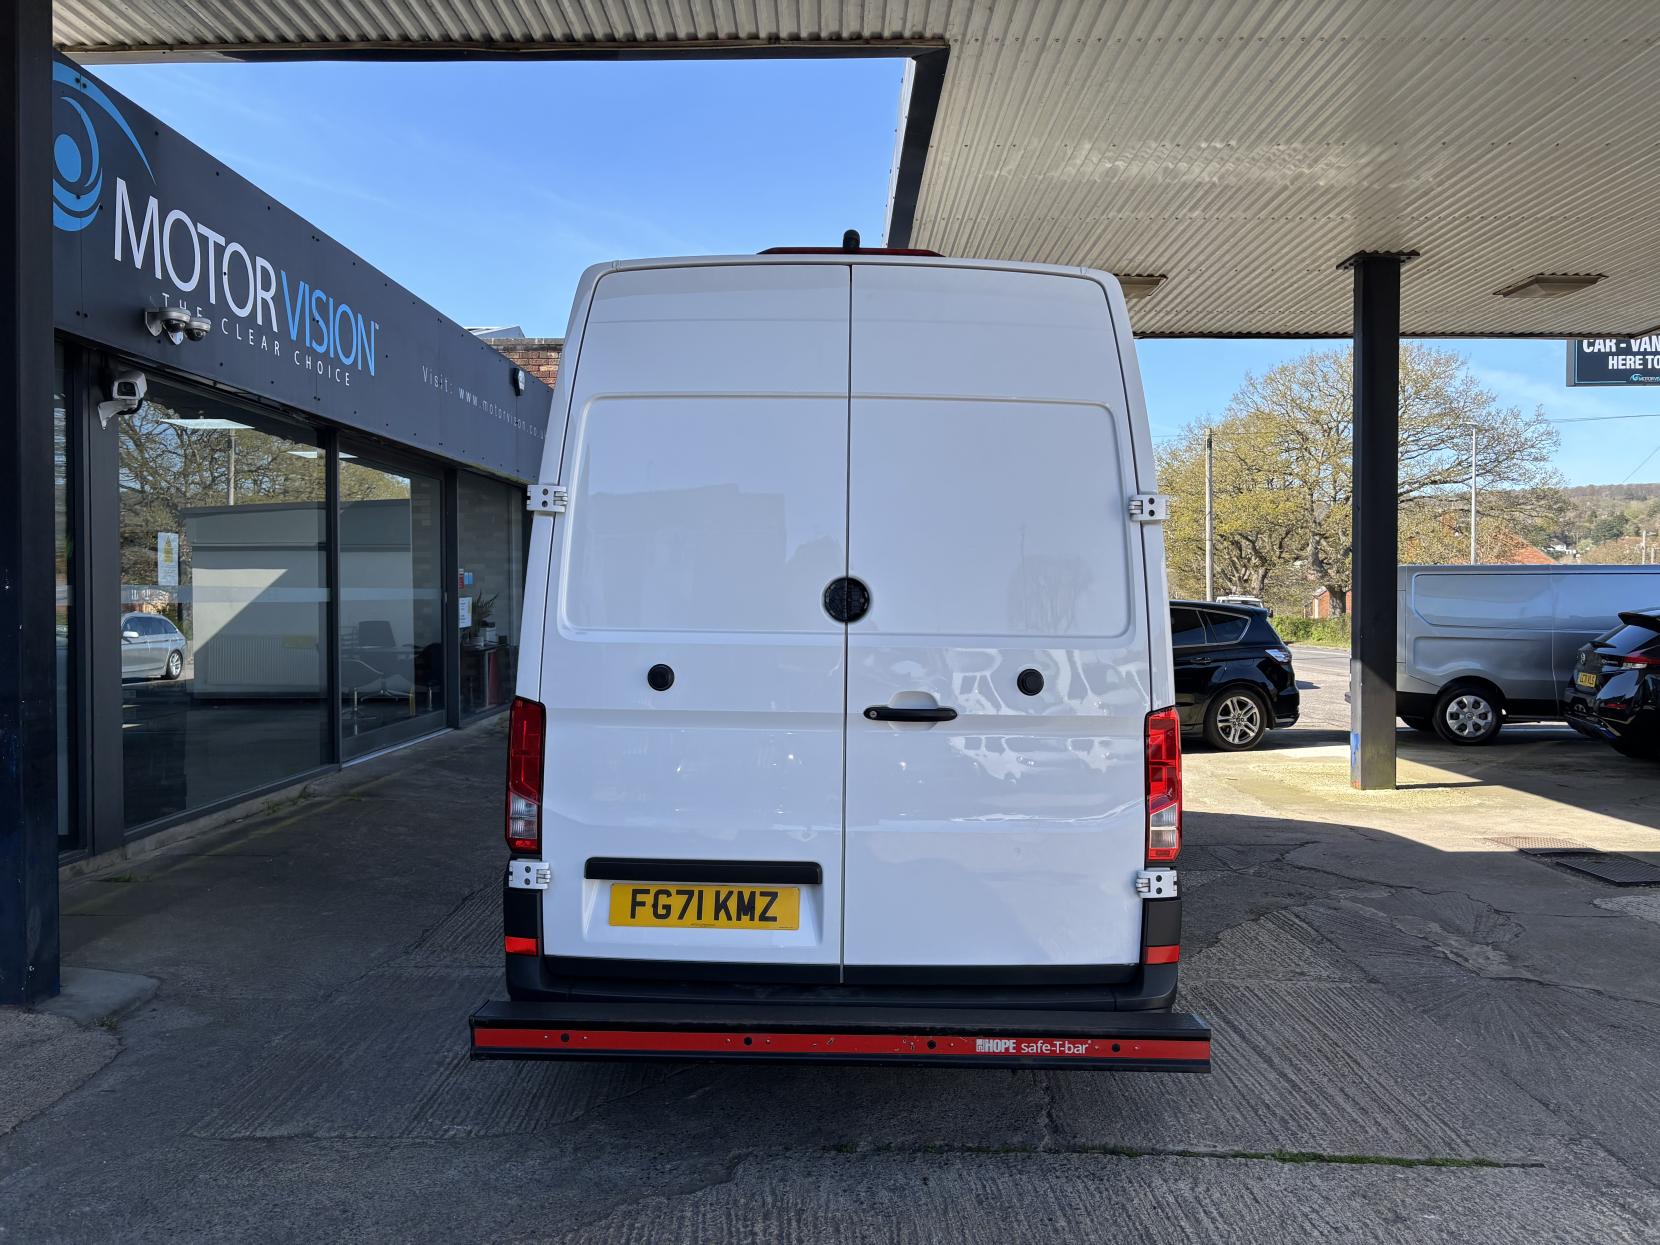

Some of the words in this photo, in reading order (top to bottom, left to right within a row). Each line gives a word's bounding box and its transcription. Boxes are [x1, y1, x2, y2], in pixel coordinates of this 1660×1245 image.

[221, 318, 280, 356] CLEAR
[294, 350, 350, 386] CHOICE
[1582, 338, 1617, 353] CAR
[1608, 355, 1643, 370] HERE
[630, 888, 704, 921] FG71
[713, 890, 779, 922] KMZ
[984, 1039, 1017, 1053] HOPE
